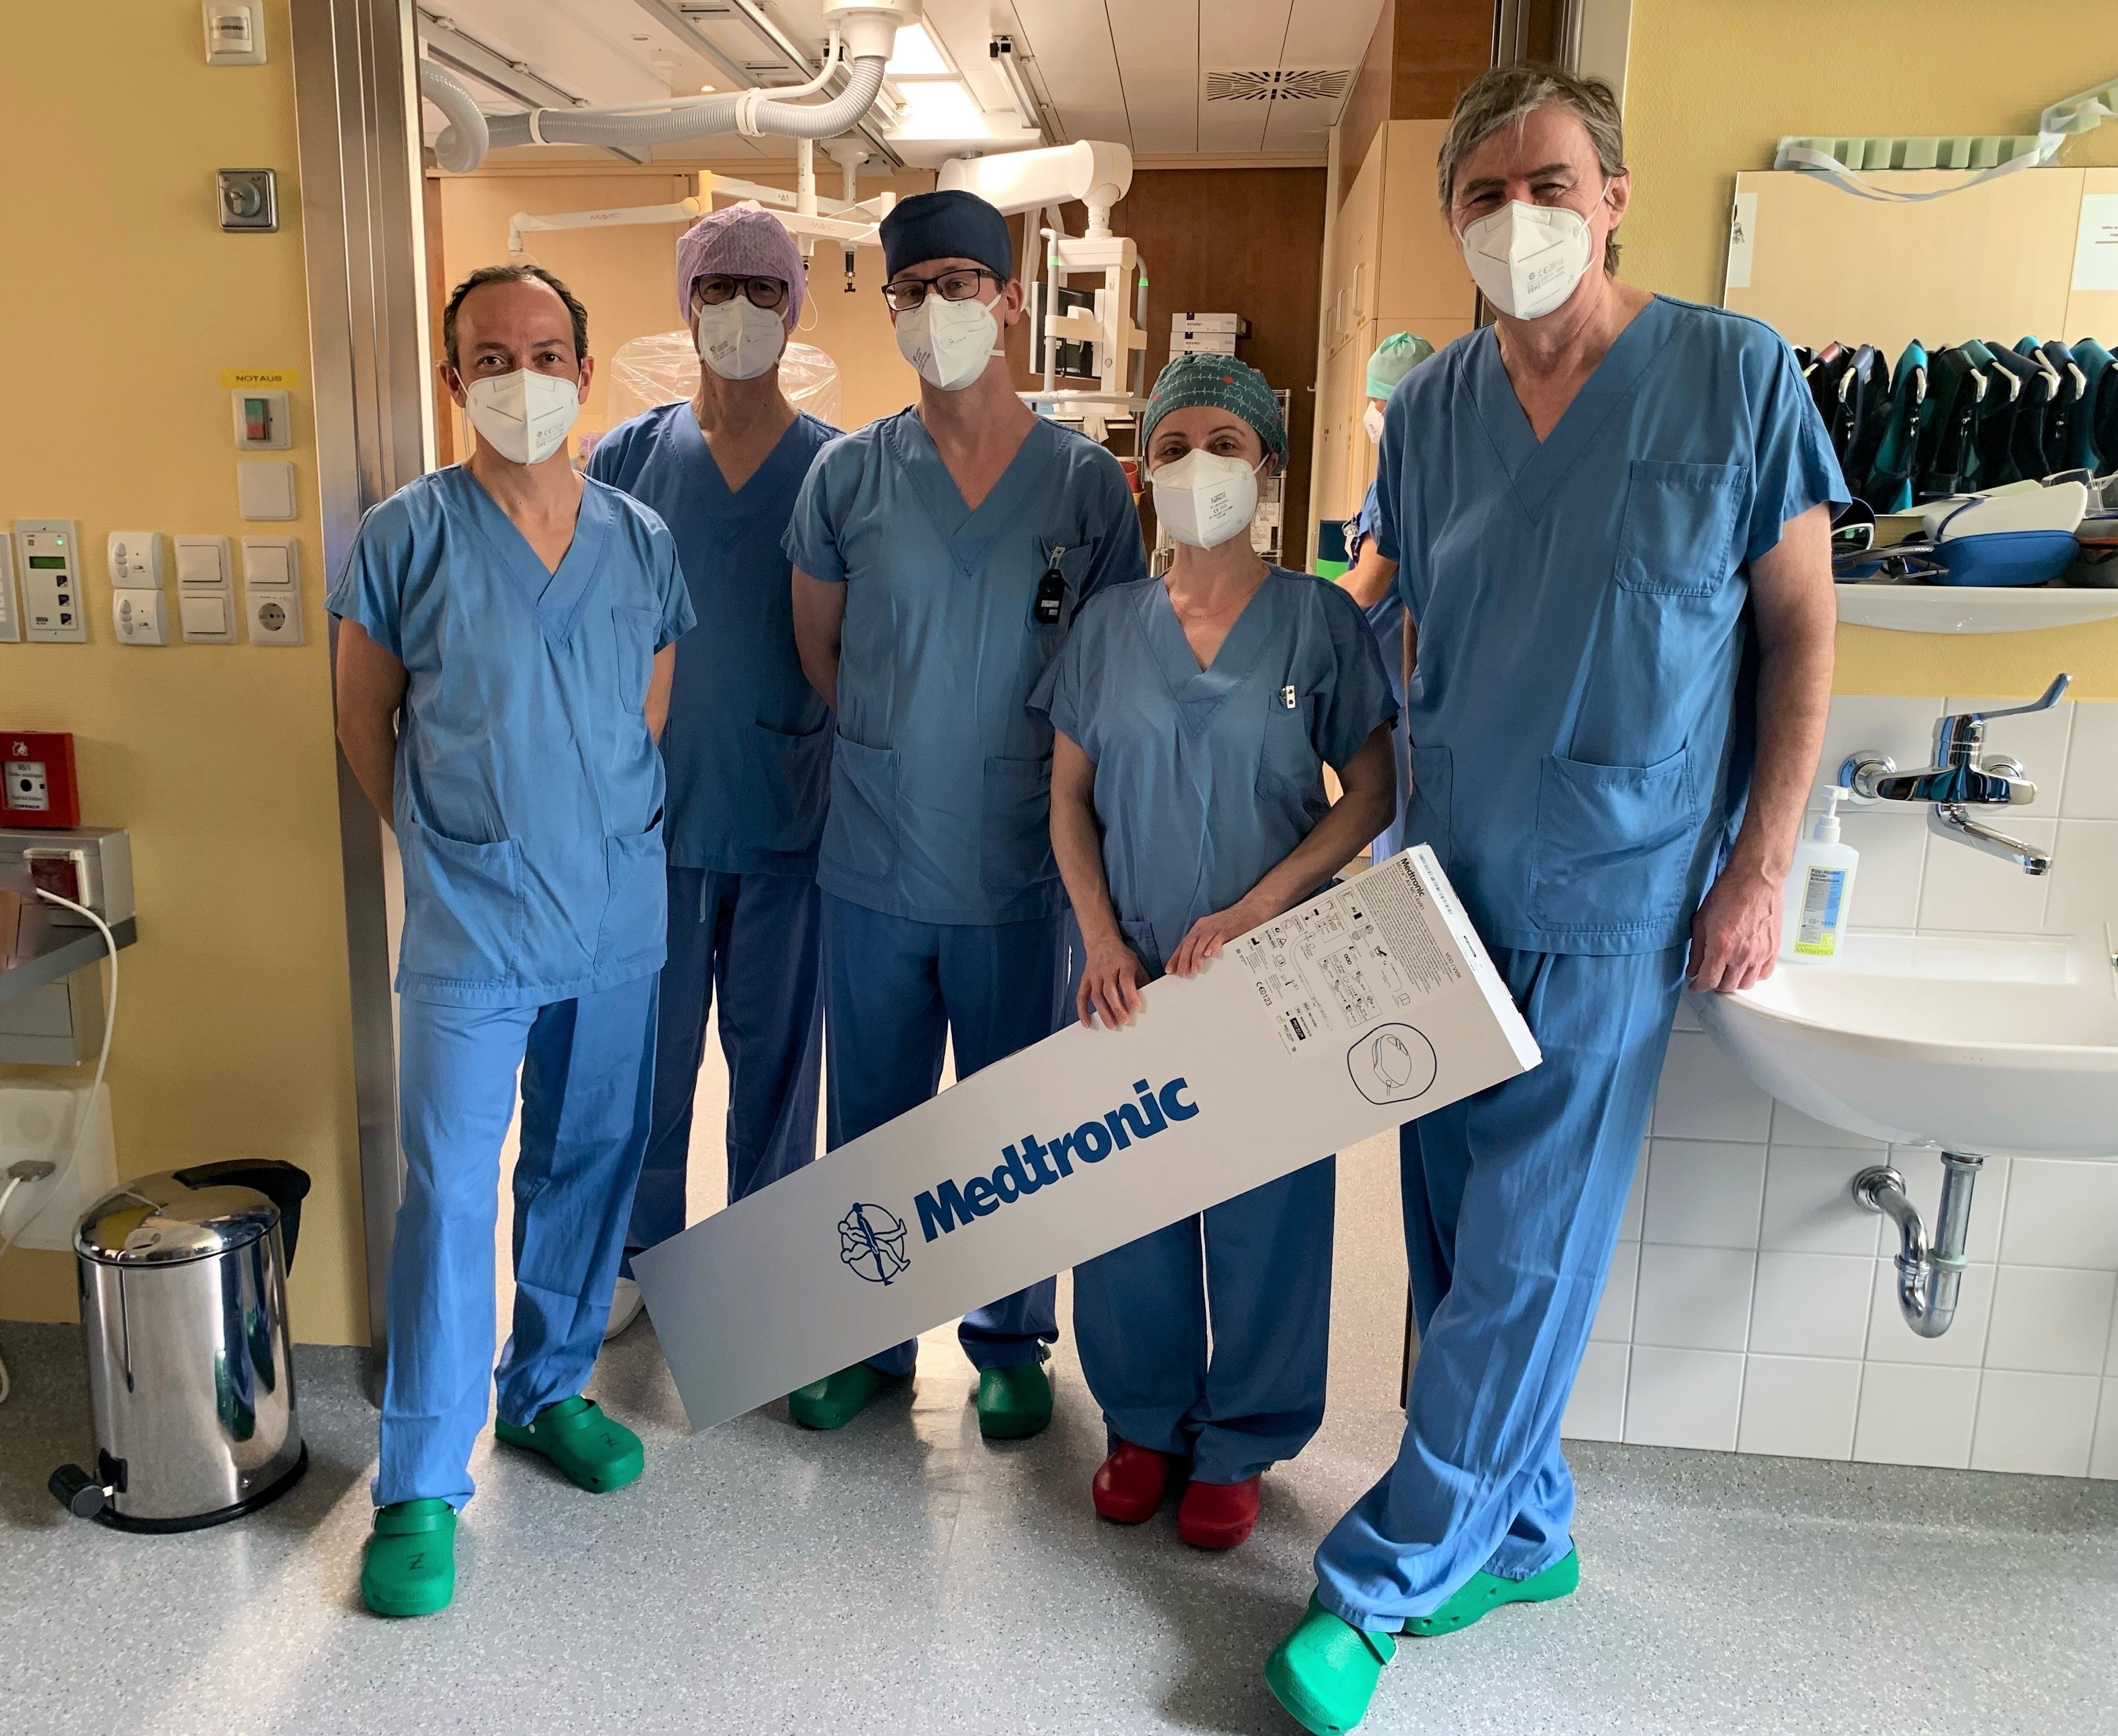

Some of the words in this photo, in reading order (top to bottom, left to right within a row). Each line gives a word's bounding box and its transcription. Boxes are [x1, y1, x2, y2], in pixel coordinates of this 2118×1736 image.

[1400, 857, 1426, 897] Medtronic
[1350, 905, 1357, 914] AV
[1409, 886, 1424, 910] MC1AVR1
[1444, 952, 1453, 964] VDD
[914, 1077, 1200, 1243] Medtronic
